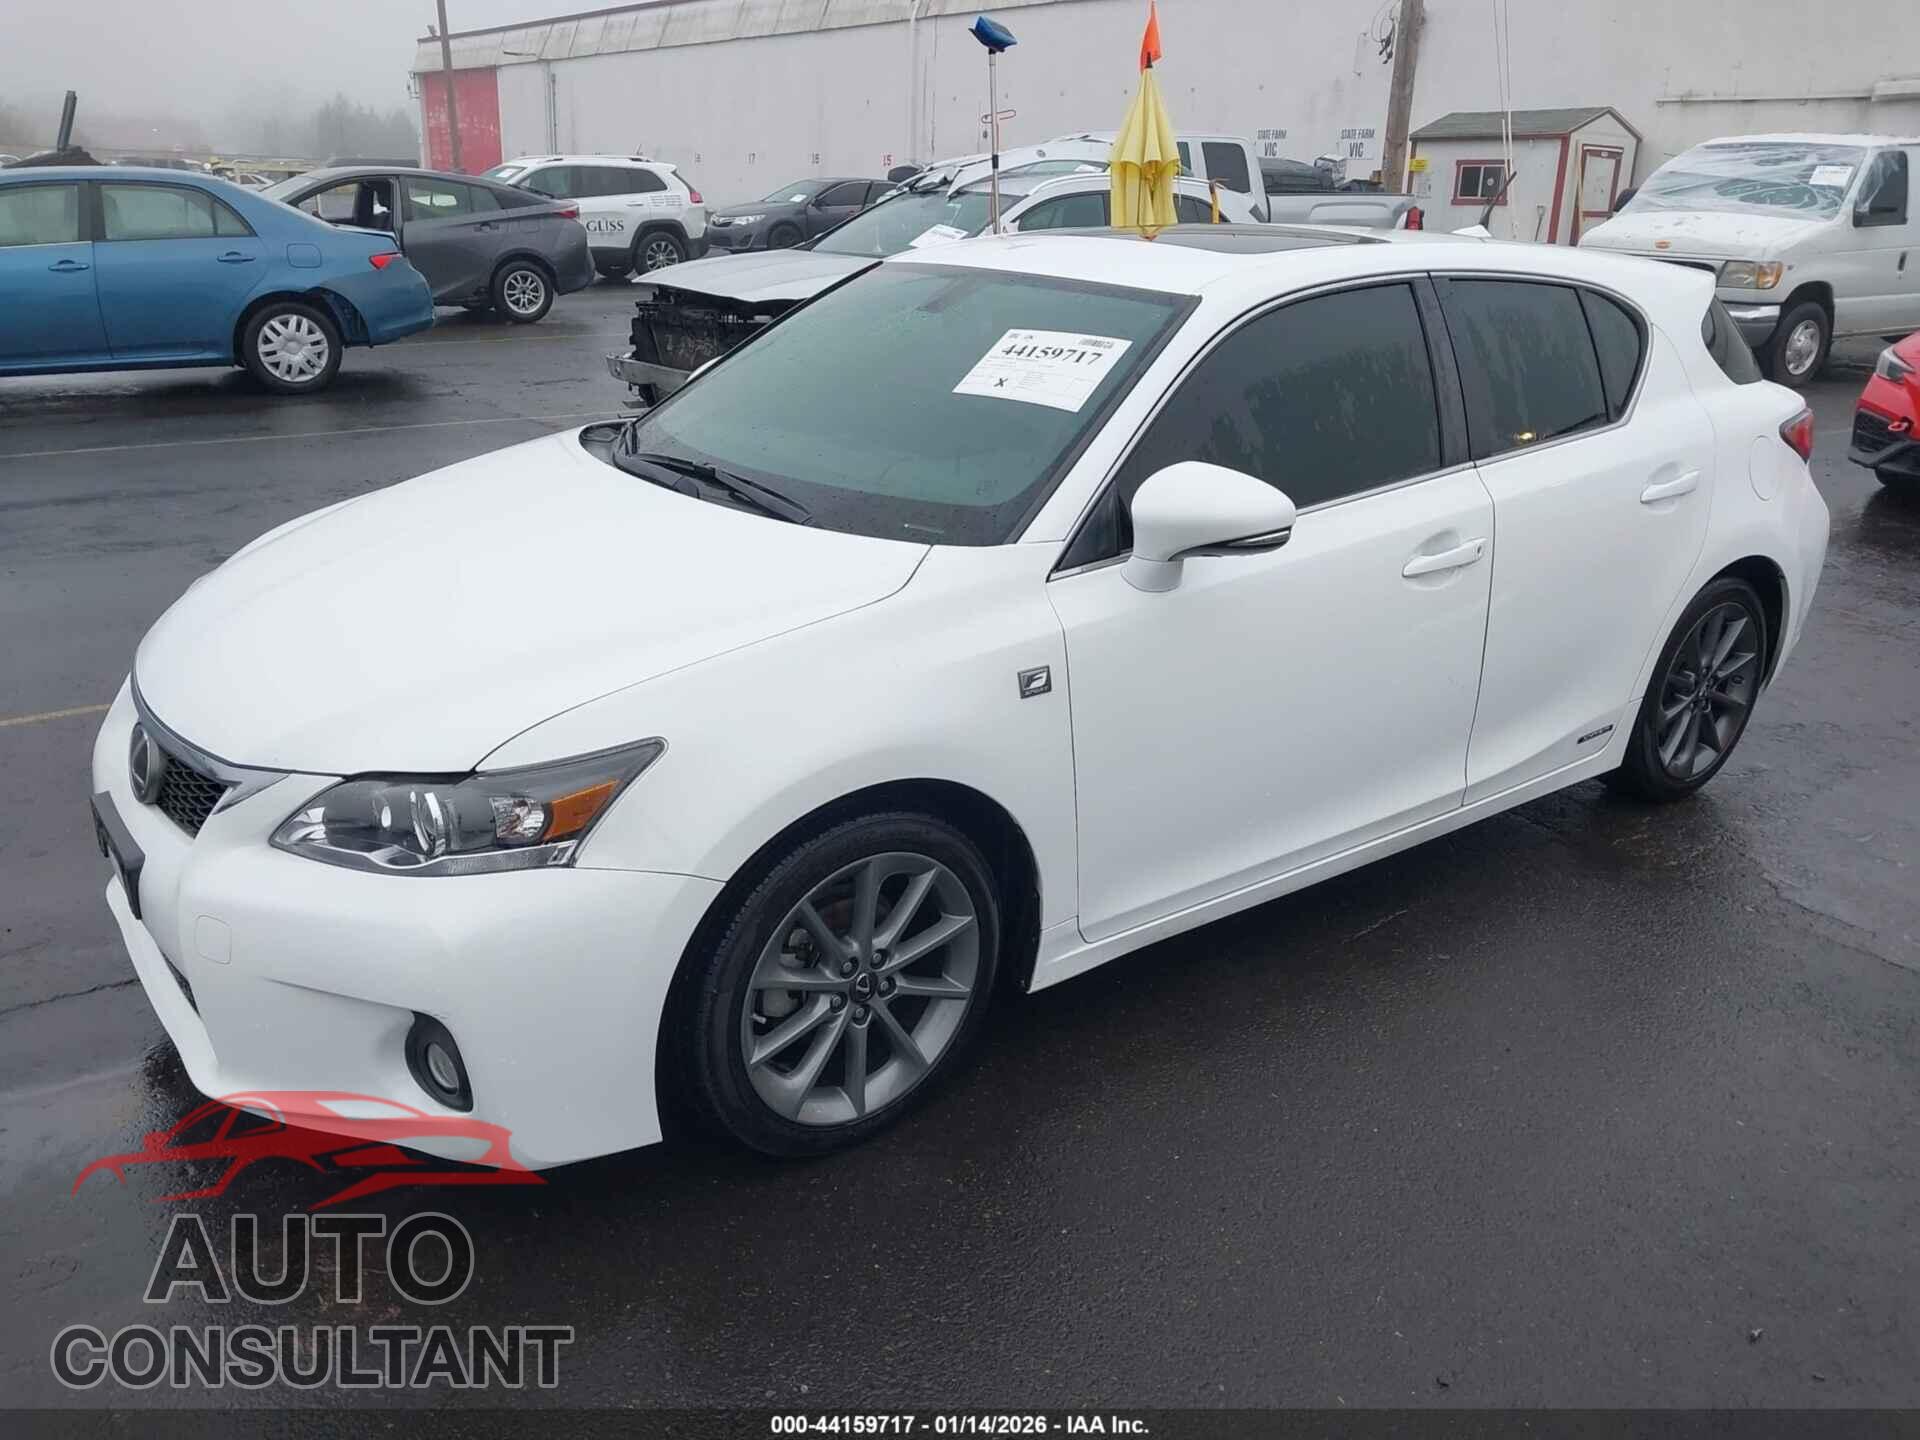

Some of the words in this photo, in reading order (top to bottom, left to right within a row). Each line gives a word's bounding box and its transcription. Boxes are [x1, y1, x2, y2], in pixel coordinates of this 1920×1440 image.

[1264, 142, 1278, 157] VIC
[1349, 142, 1364, 157] VIC
[882, 154, 892, 166] 15
[1001, 343, 1103, 365] 44159717
